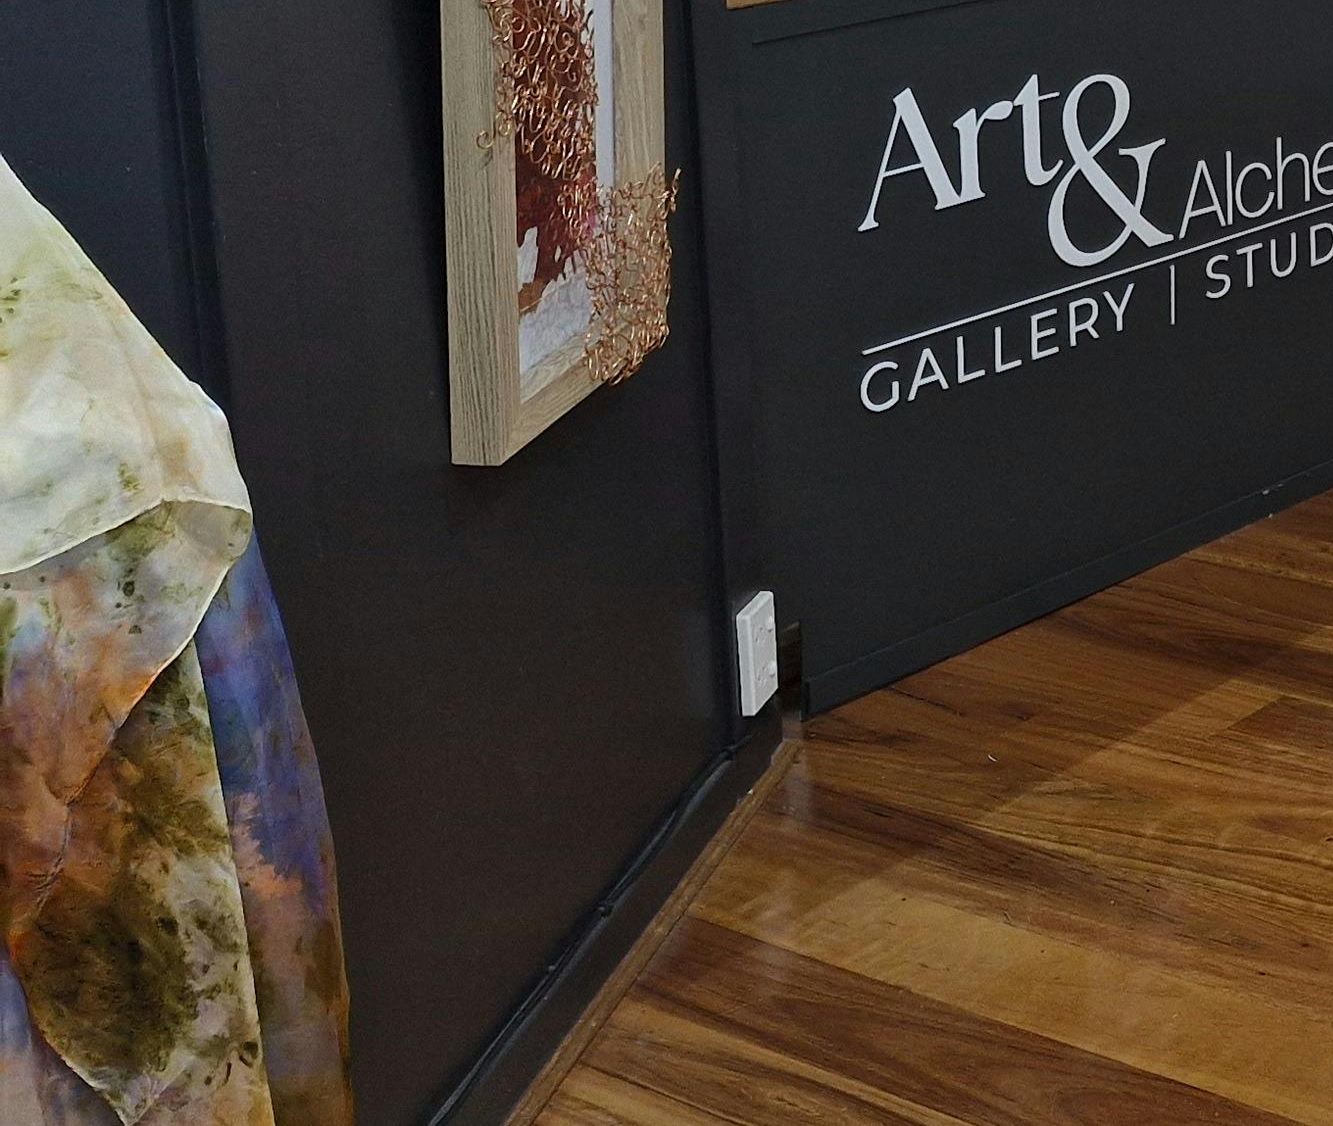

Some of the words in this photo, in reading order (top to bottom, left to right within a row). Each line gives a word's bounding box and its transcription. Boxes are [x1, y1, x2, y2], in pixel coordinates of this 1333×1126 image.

[858, 74, 1065, 232] Art
[1047, 73, 1174, 268] &
[859, 282, 1135, 413] GALLERY
